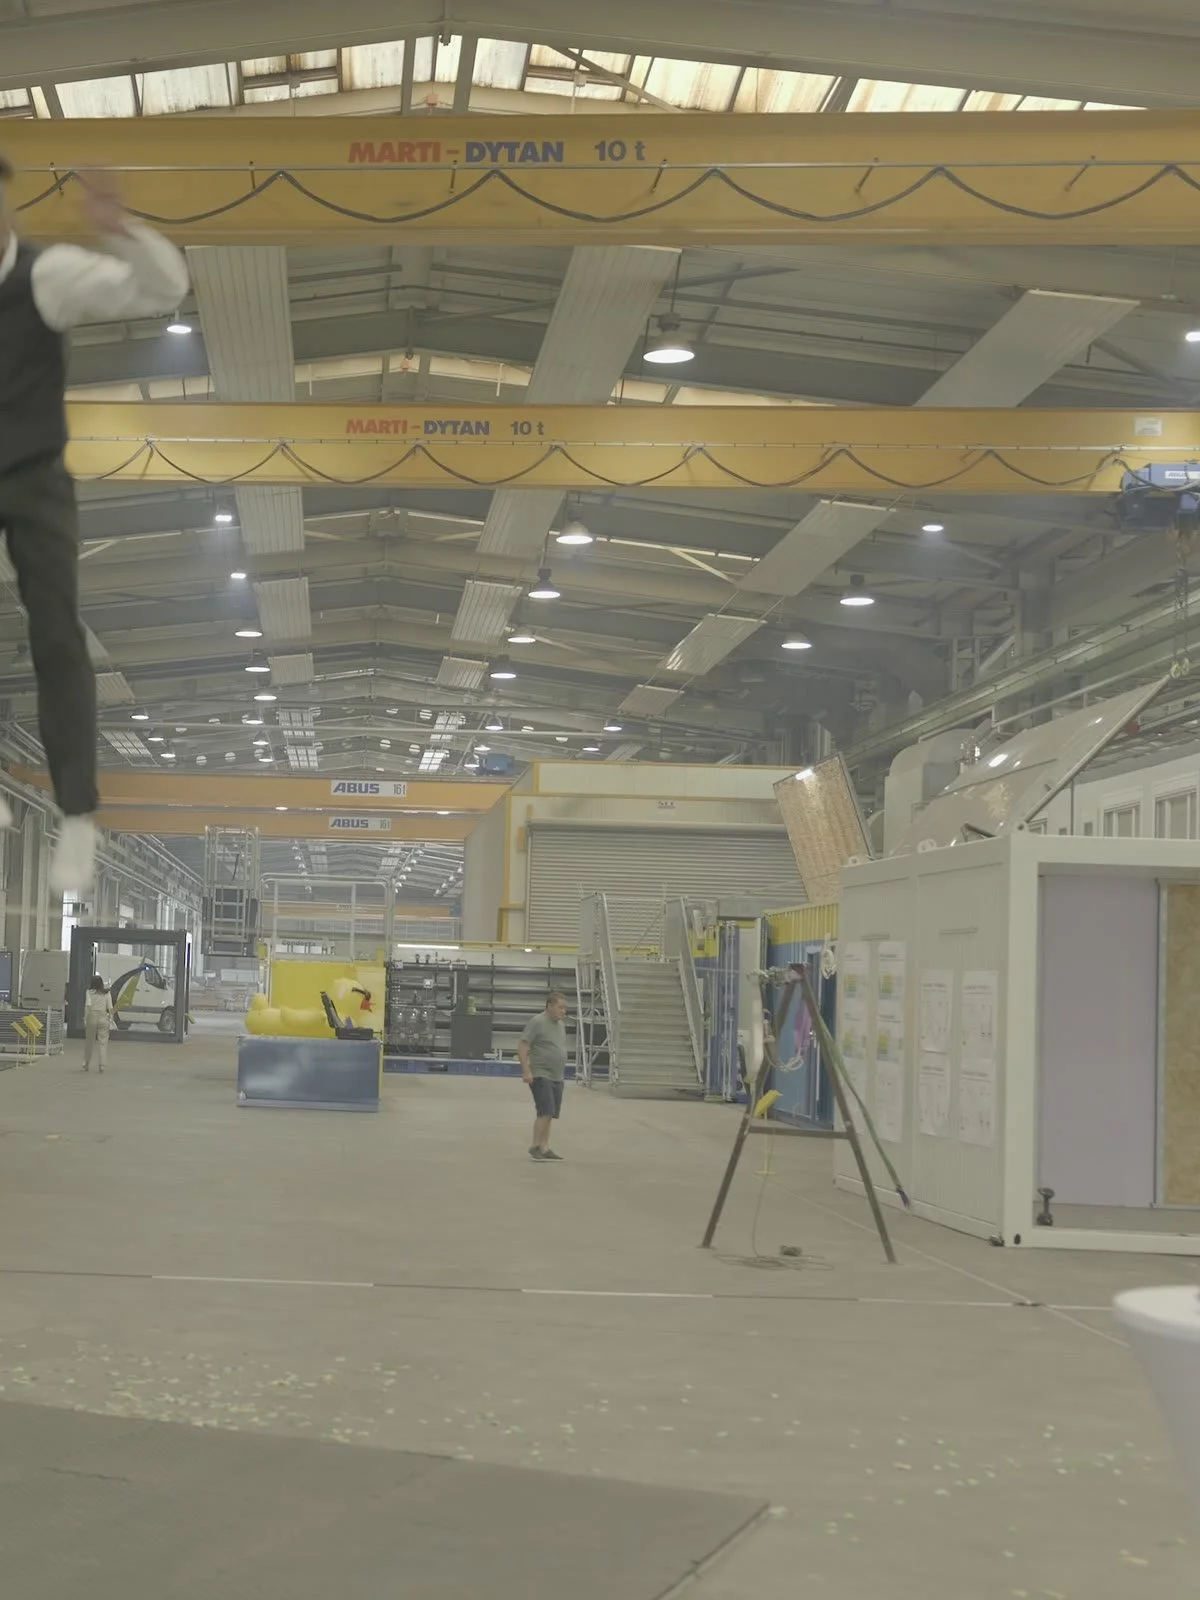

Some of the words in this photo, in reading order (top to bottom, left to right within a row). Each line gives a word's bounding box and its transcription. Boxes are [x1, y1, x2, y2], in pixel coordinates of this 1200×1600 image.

[347, 141, 442, 163] MARTI
[465, 141, 564, 163] DYTAN
[346, 420, 408, 434] MARTI
[424, 420, 490, 435] DYTAN
[333, 782, 380, 794] ABUS
[330, 819, 369, 828] ABUS
